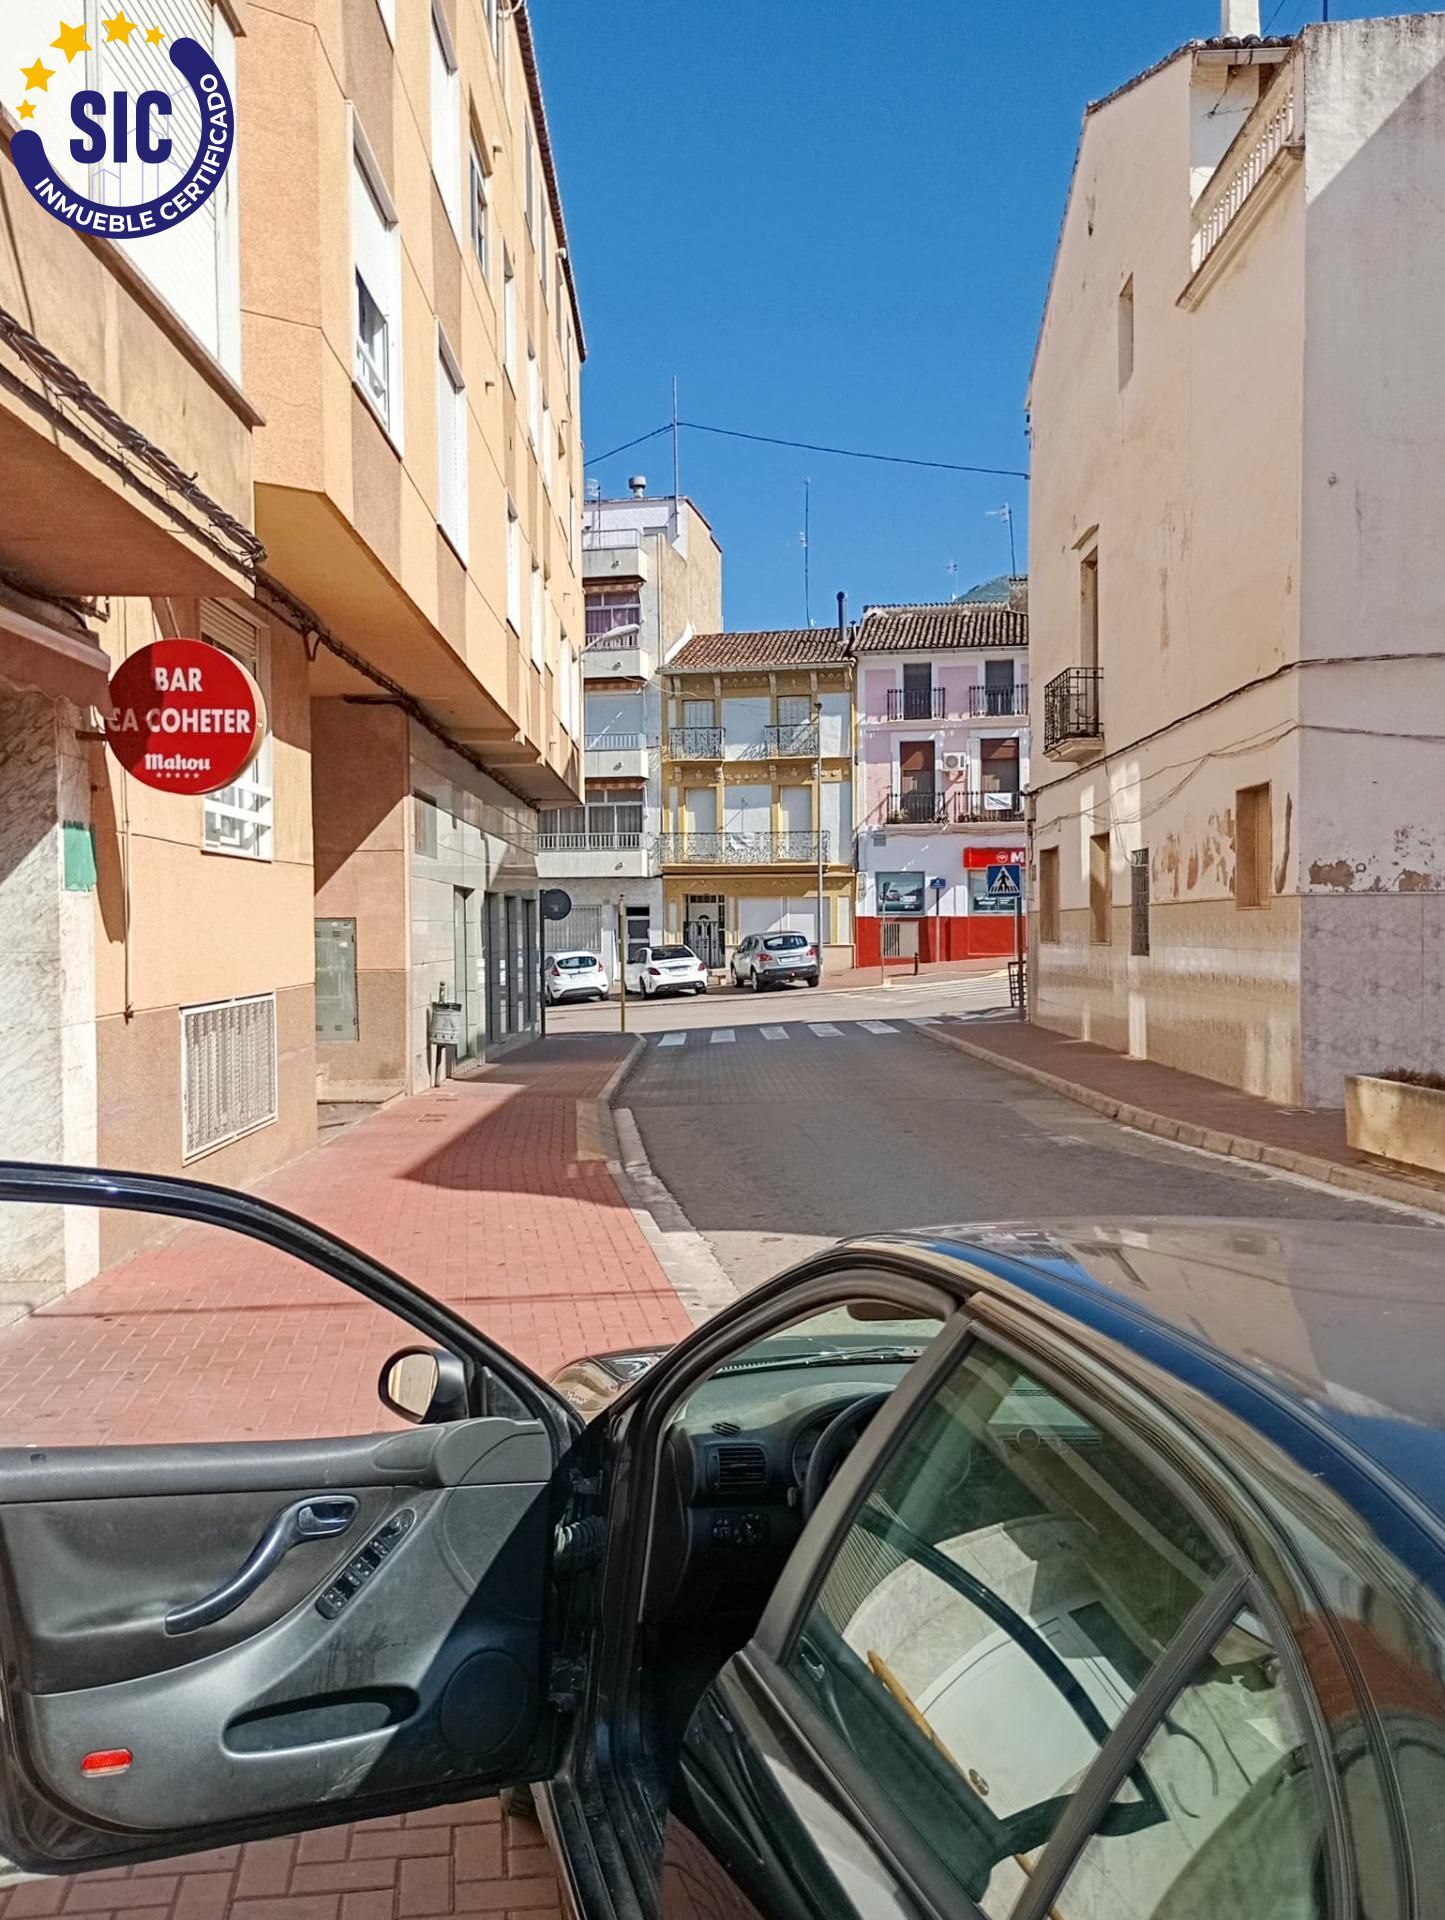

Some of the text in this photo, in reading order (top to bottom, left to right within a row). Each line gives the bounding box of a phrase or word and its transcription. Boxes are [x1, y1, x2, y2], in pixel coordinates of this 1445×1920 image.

[154, 667, 203, 692] BAR
[146, 708, 251, 733] COHETER
[144, 753, 211, 770] Mahou
